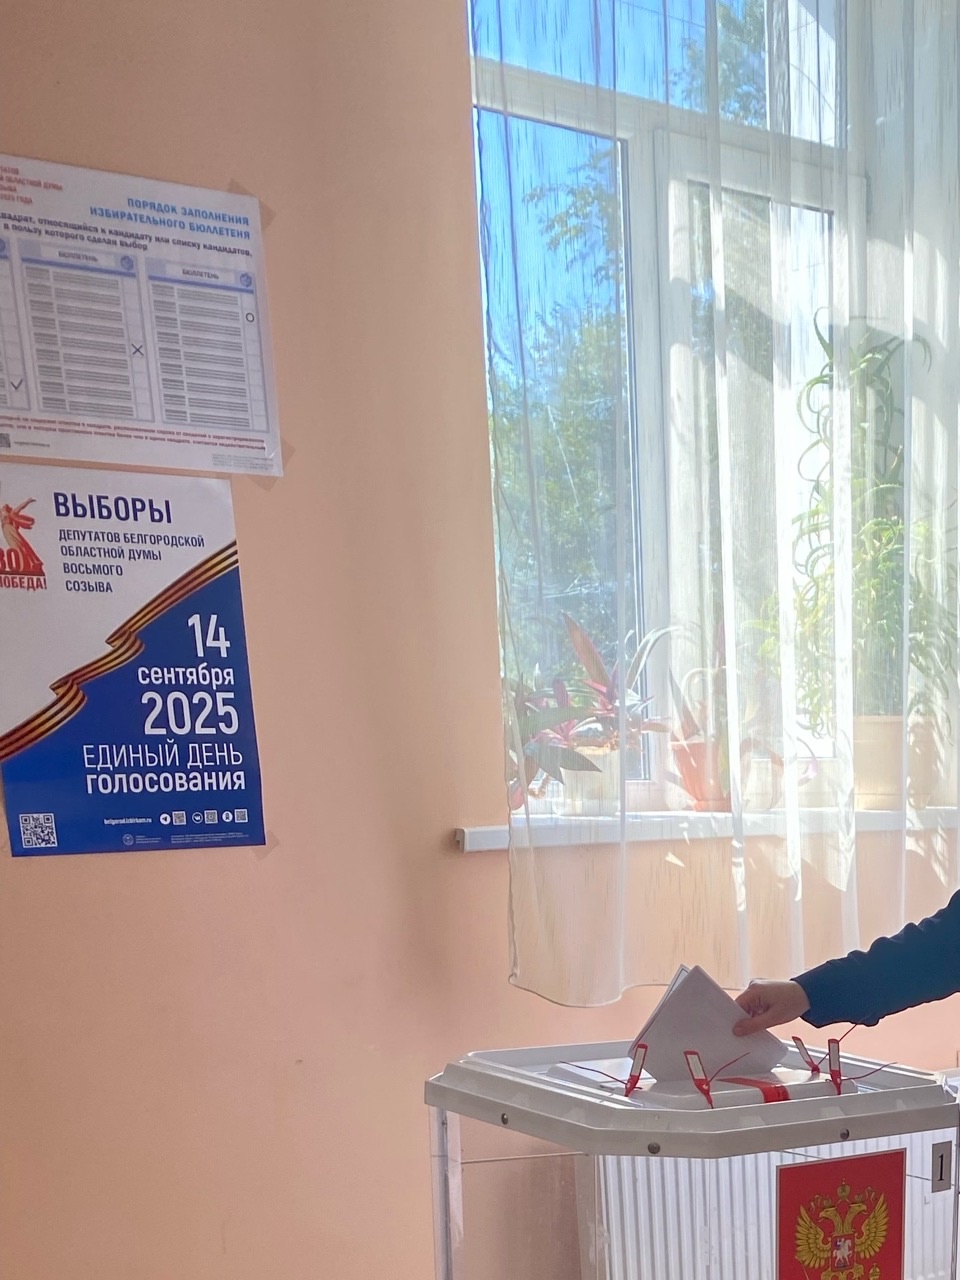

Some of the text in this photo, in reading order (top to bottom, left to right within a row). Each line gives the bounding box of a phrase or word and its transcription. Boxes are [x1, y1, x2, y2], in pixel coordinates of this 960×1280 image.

[89, 206, 251, 240] ИЗБИРАТЕЛЬНОГО БЮЛЛЕТЕНЯ
[127, 198, 249, 226] ПОРЯДОК ЗАПОЛНЕНИЯ
[12, 224, 42, 236] пользу
[45, 229, 85, 240] которого
[86, 235, 117, 246] сделан
[120, 239, 148, 251] выбор
[38, 217, 98, 233] относящийся
[108, 229, 152, 243] кандидату
[154, 236, 170, 244] или
[172, 239, 201, 250] списку
[203, 243, 253, 257] кандидатов,
[53, 492, 172, 523] ВЫБОРЫ
[59, 529, 205, 548] ДЕПУТАТОВ БЕЛГОРОДСКОЙ
[60, 545, 162, 561] ОБЛАСТНОЙ ДУМЫ
[63, 562, 123, 576] ВОСЬМОГО
[65, 580, 113, 593] СОЗЫВА
[187, 614, 231, 658] 14
[138, 662, 235, 690] сентября
[141, 691, 239, 735] 2025
[83, 738, 243, 771] ЕДИНЫЙ ДЕНЬ
[86, 770, 246, 794] голосования
[938, 1153, 945, 1182] 1
